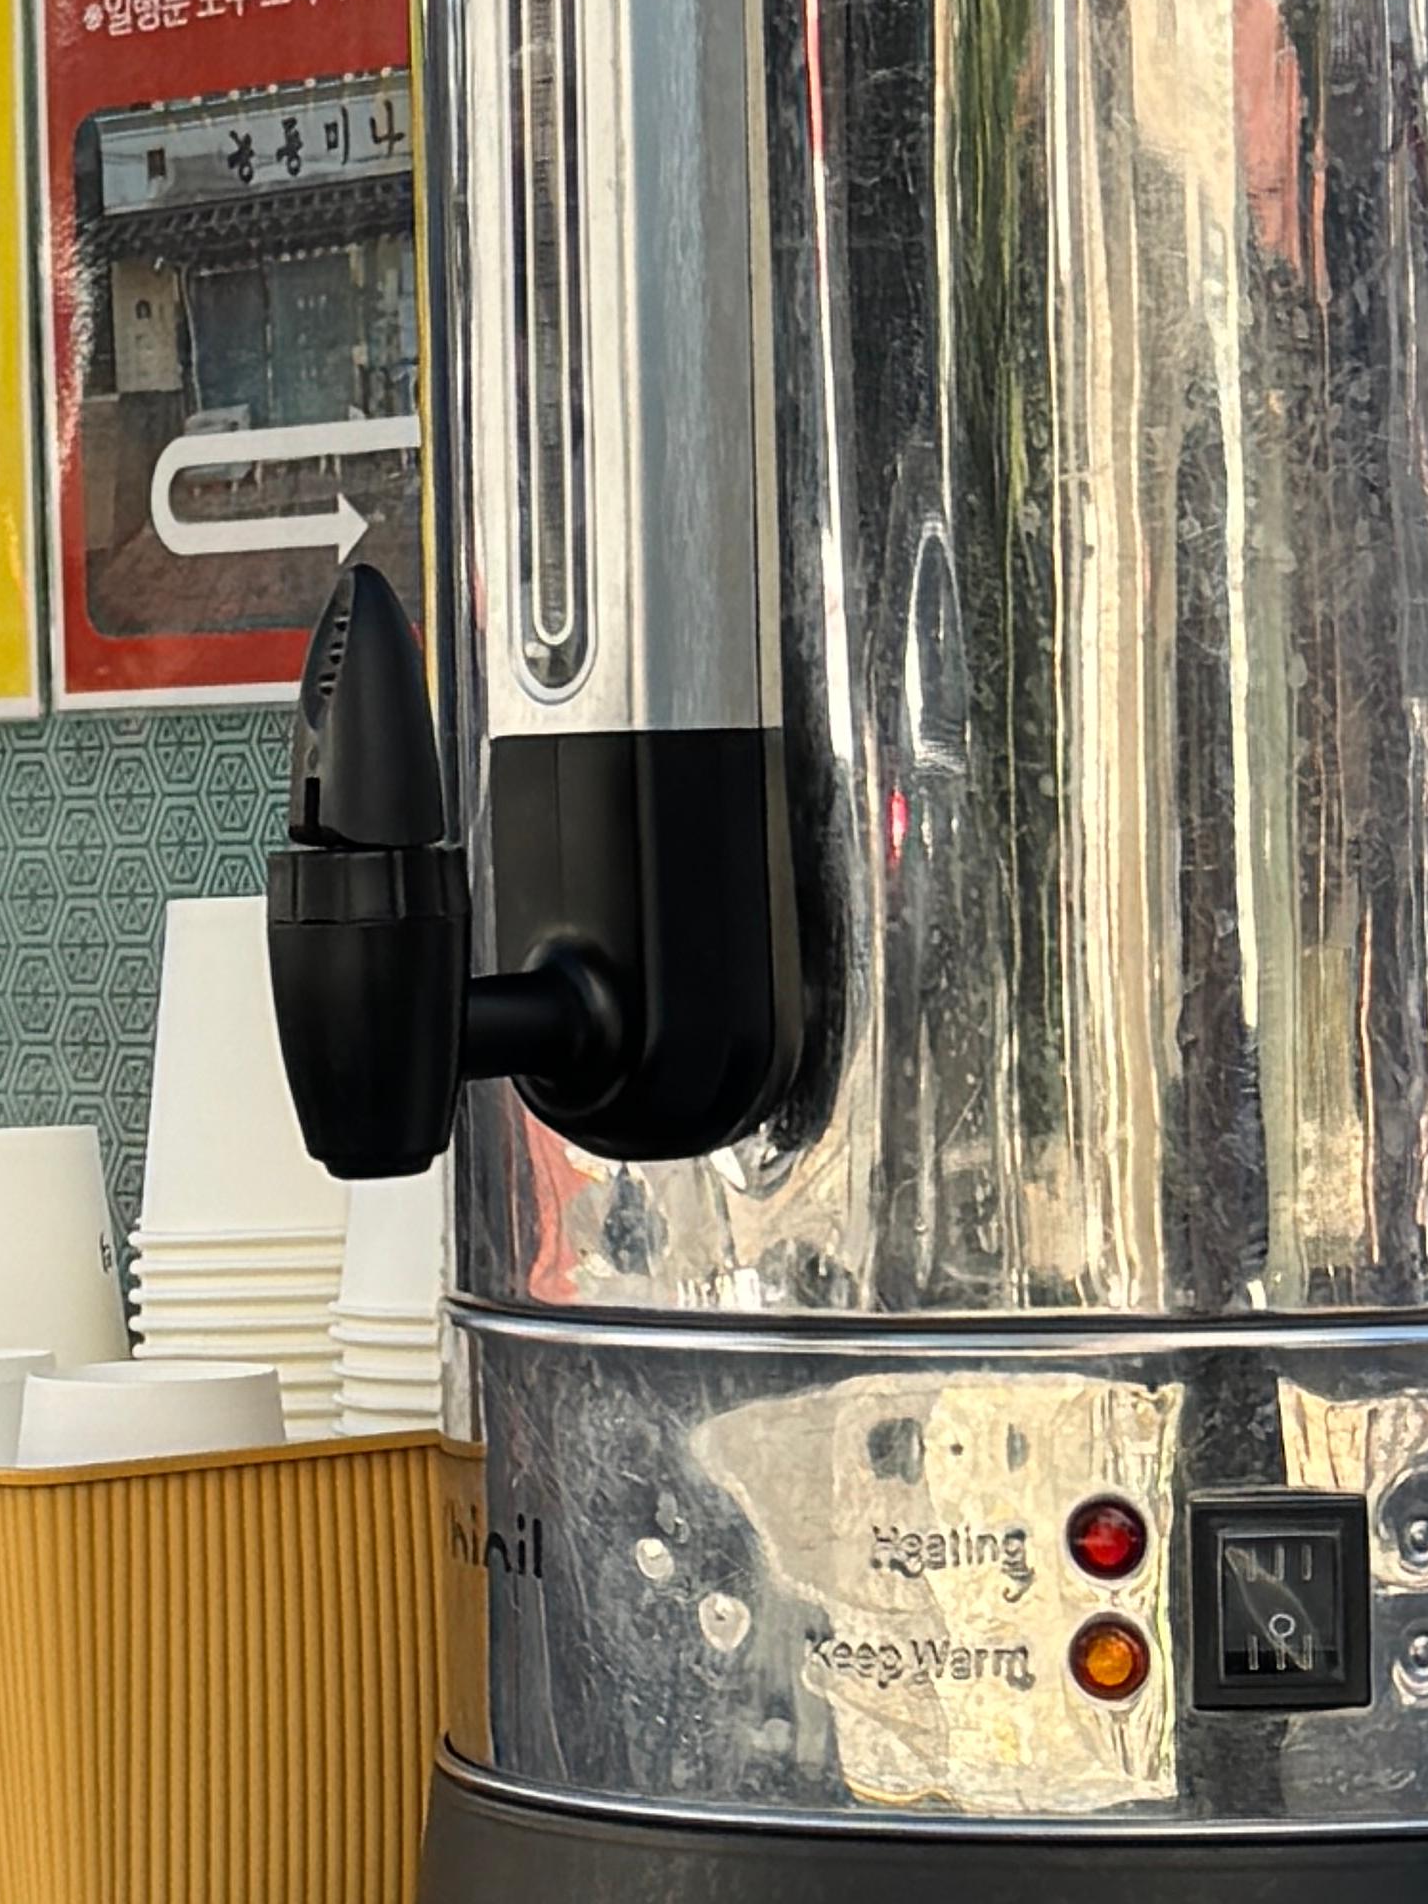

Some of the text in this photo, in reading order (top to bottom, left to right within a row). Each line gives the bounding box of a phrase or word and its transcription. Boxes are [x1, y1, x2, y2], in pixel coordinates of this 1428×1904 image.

[869, 1524, 1035, 1603] Heating
[804, 1627, 1037, 1691] Keep Warm
